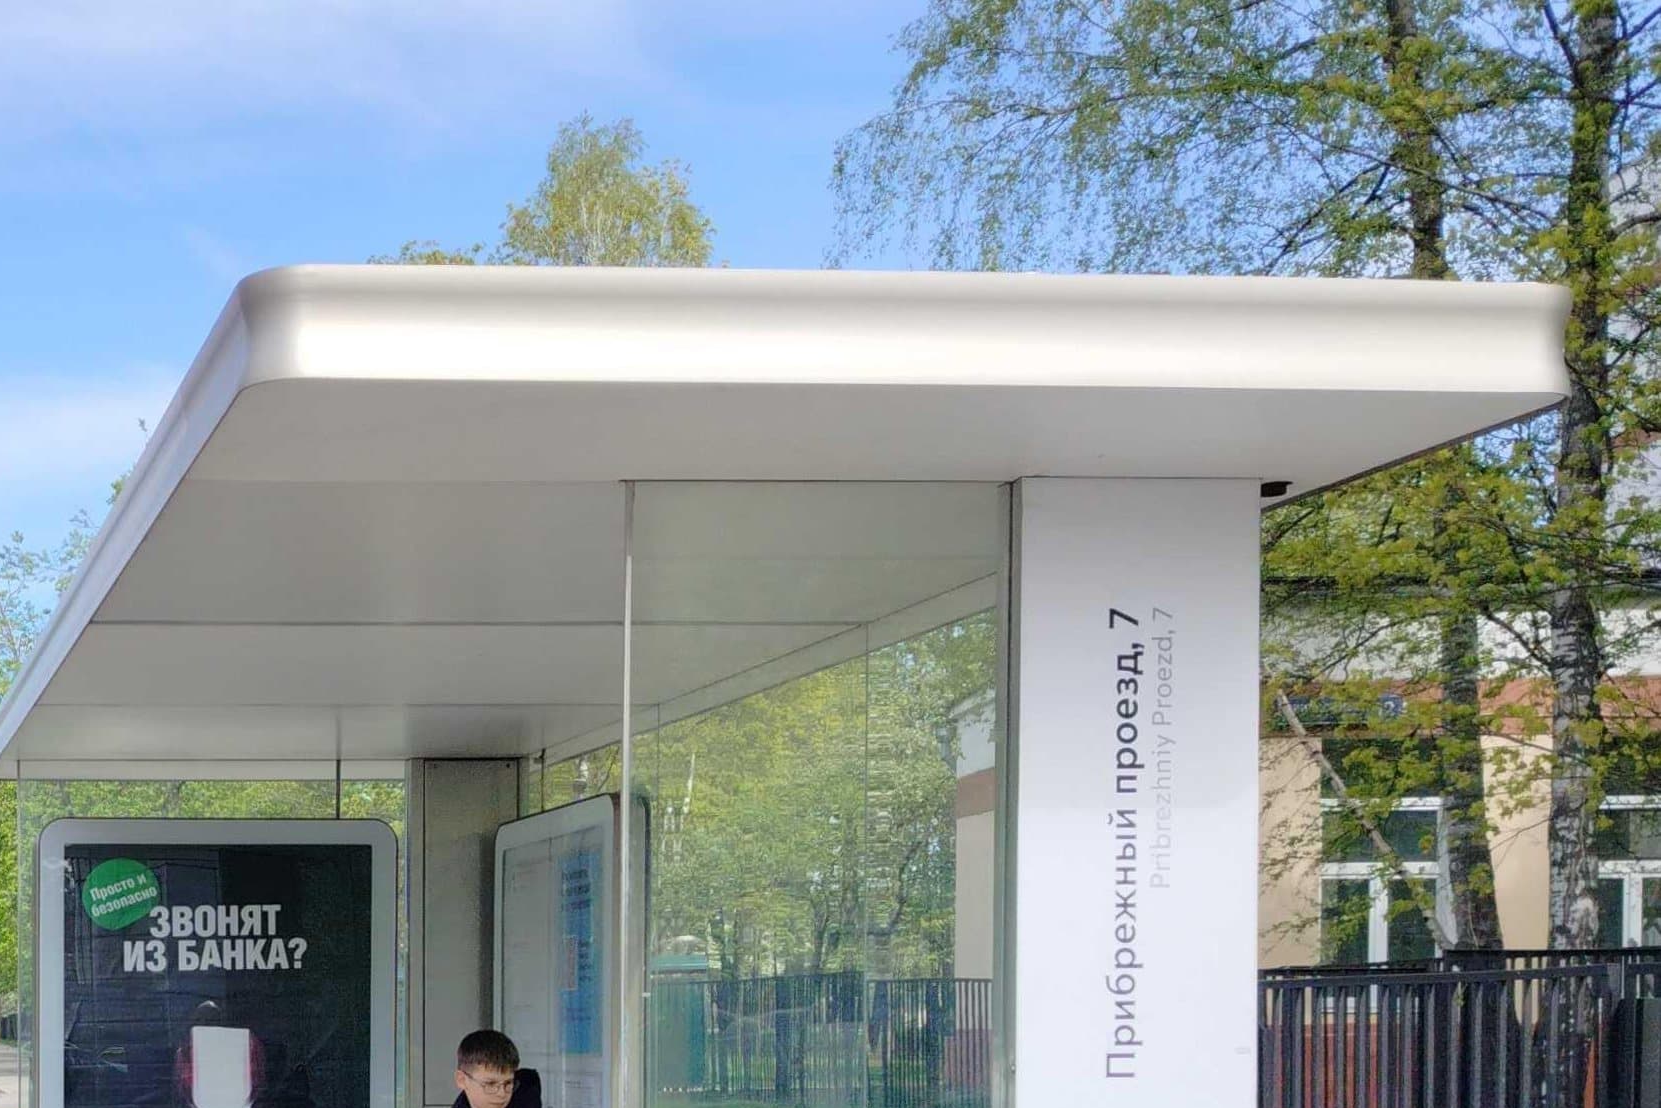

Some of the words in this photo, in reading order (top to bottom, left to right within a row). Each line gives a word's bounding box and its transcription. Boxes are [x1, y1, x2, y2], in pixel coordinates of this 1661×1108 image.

[1109, 608, 1140, 630] 7
[1152, 606, 1174, 621] 7
[1151, 628, 1175, 726] Proezd,
[1114, 641, 1145, 794] проезд,
[1150, 733, 1177, 889] Pribrezhniy
[90, 877, 135, 902] Просто
[137, 873, 147, 885] и
[91, 886, 158, 918] безопасно
[149, 904, 282, 938] ЗВОНЯТ
[123, 940, 168, 972] ИЗ
[178, 937, 308, 971] БАНКА?
[1105, 808, 1144, 1079] Прибрежный
